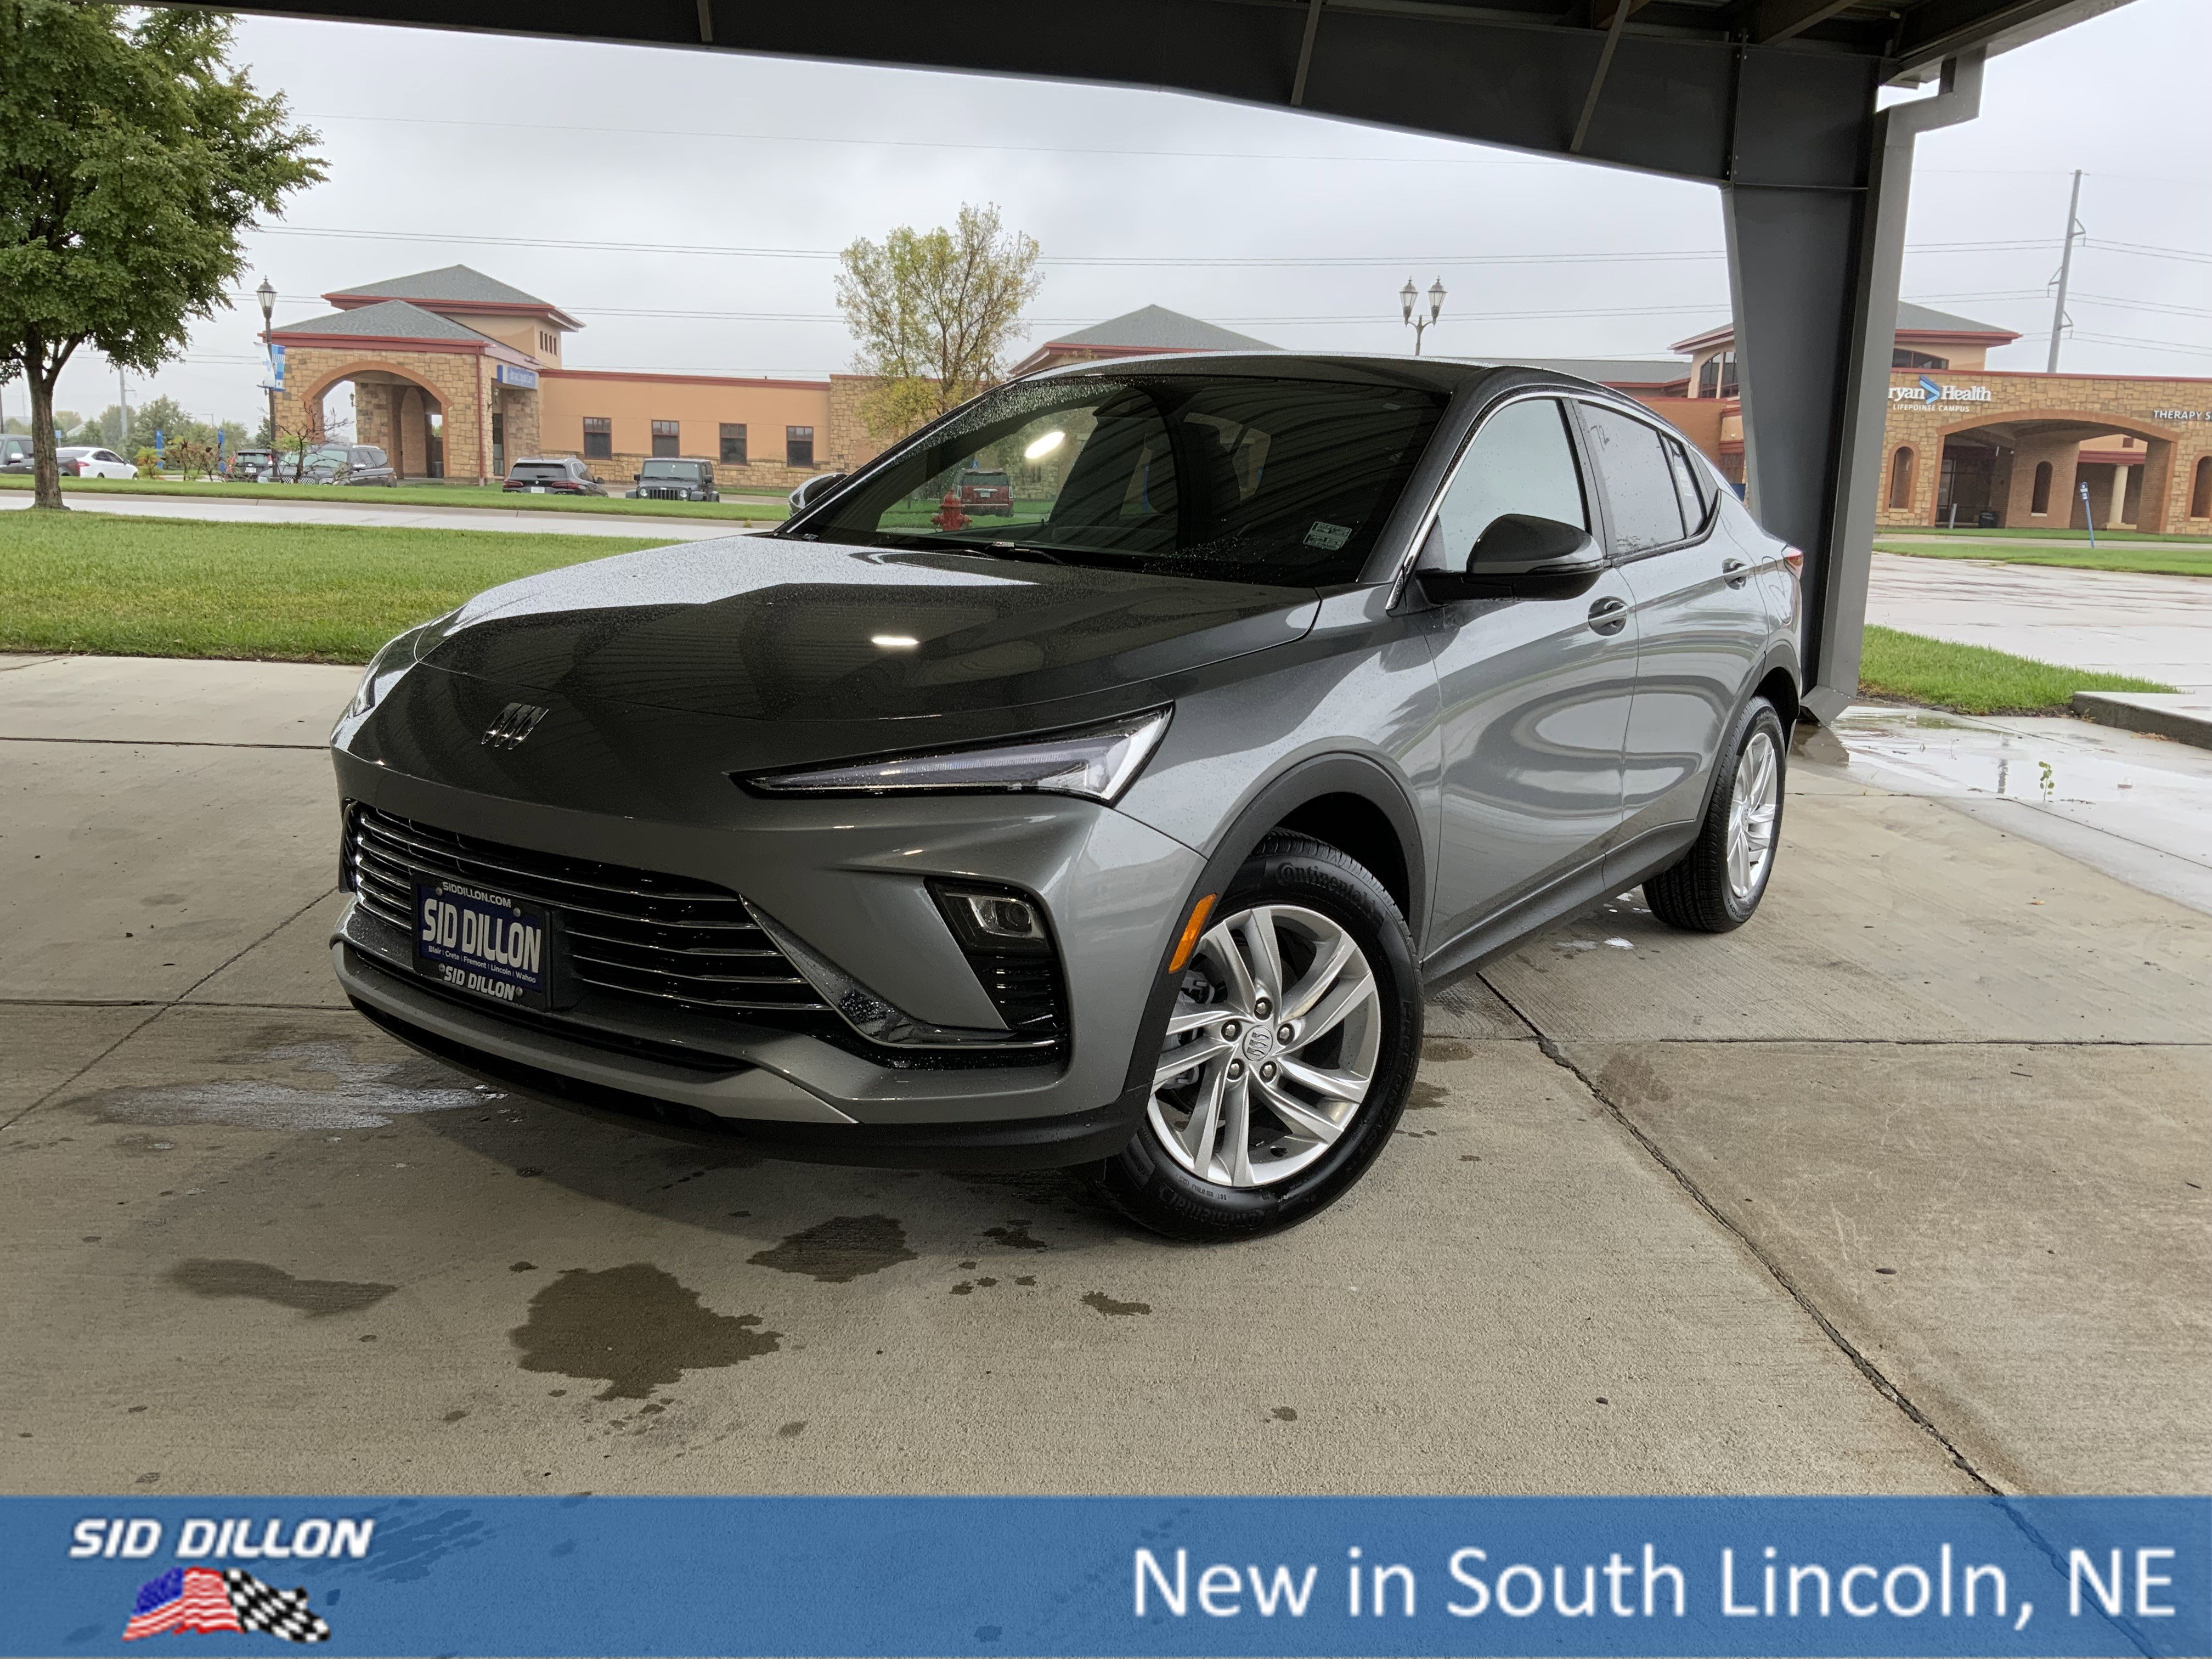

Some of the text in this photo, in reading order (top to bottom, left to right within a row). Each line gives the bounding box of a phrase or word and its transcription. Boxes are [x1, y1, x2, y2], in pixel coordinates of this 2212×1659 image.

[1940, 386, 1991, 401] Health
[2153, 410, 2212, 420] THERAPY S
[442, 881, 511, 908] SIDDILLON.COM
[422, 898, 541, 973] SID DILLON
[428, 945, 536, 983] Blair Crete Fremont Lincoln Wahoo
[444, 966, 516, 1001] SID DILLON
